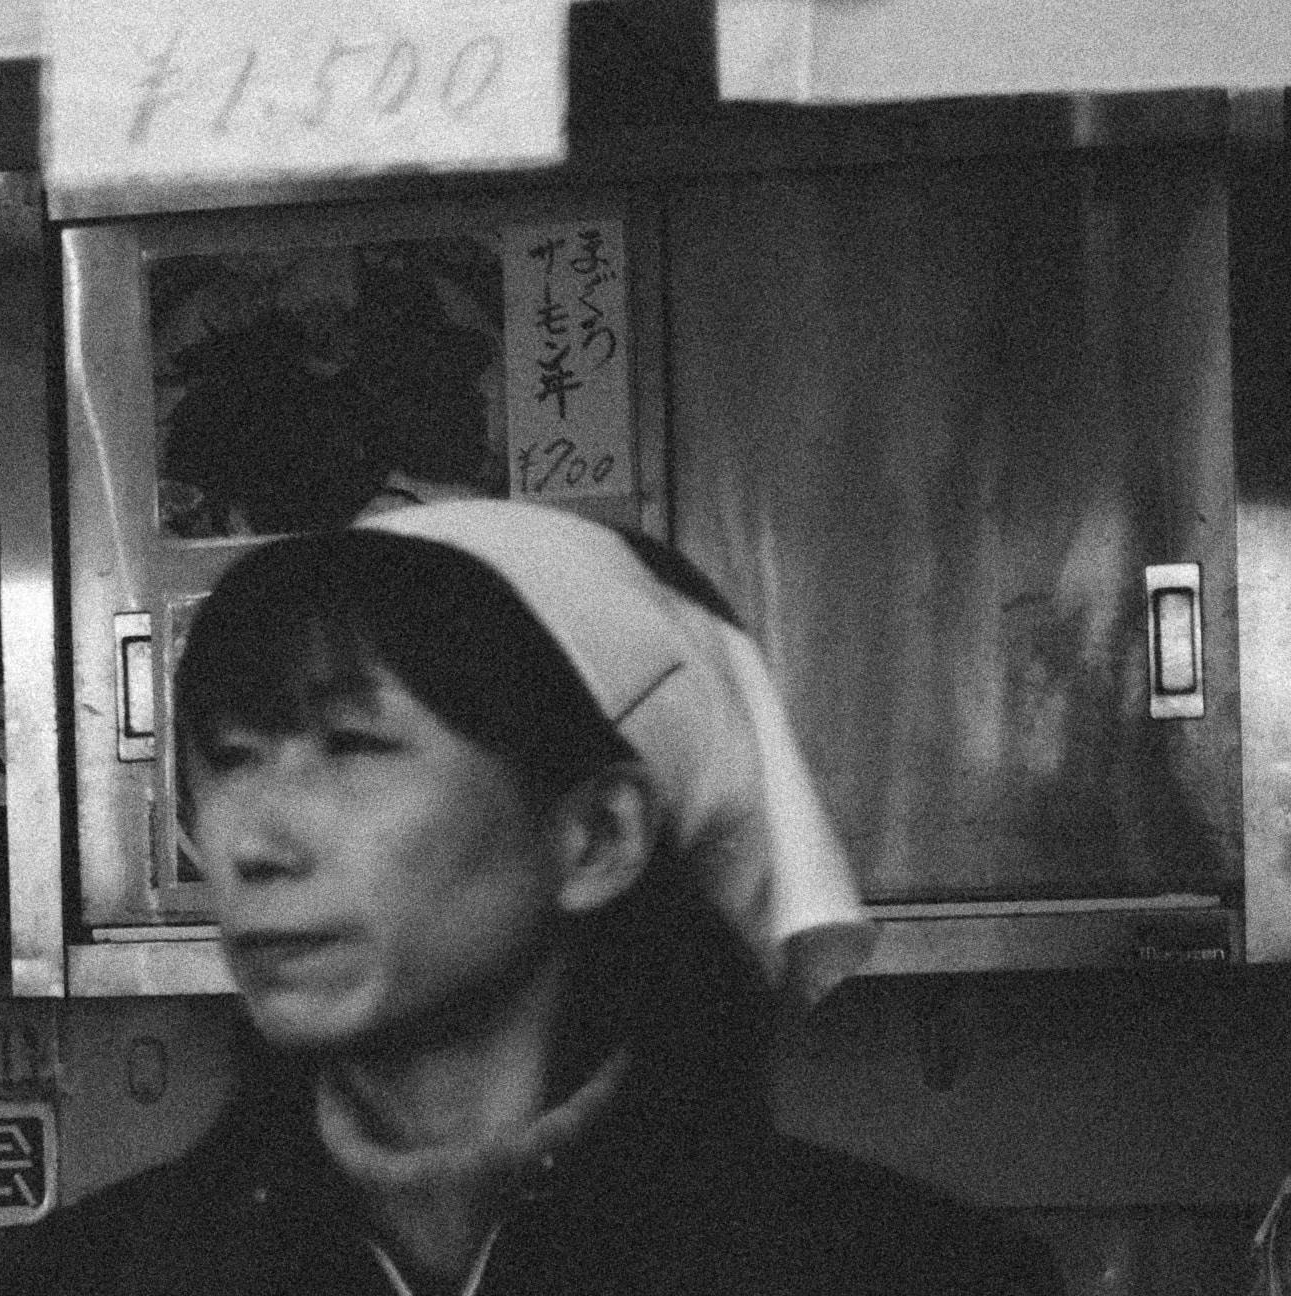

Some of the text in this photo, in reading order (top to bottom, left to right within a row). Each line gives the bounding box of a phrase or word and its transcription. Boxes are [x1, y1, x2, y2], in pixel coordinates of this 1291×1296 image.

[528, 237, 584, 420] サーモン丼
[570, 228, 617, 368] まぐろ
[518, 437, 615, 494] ¥700
